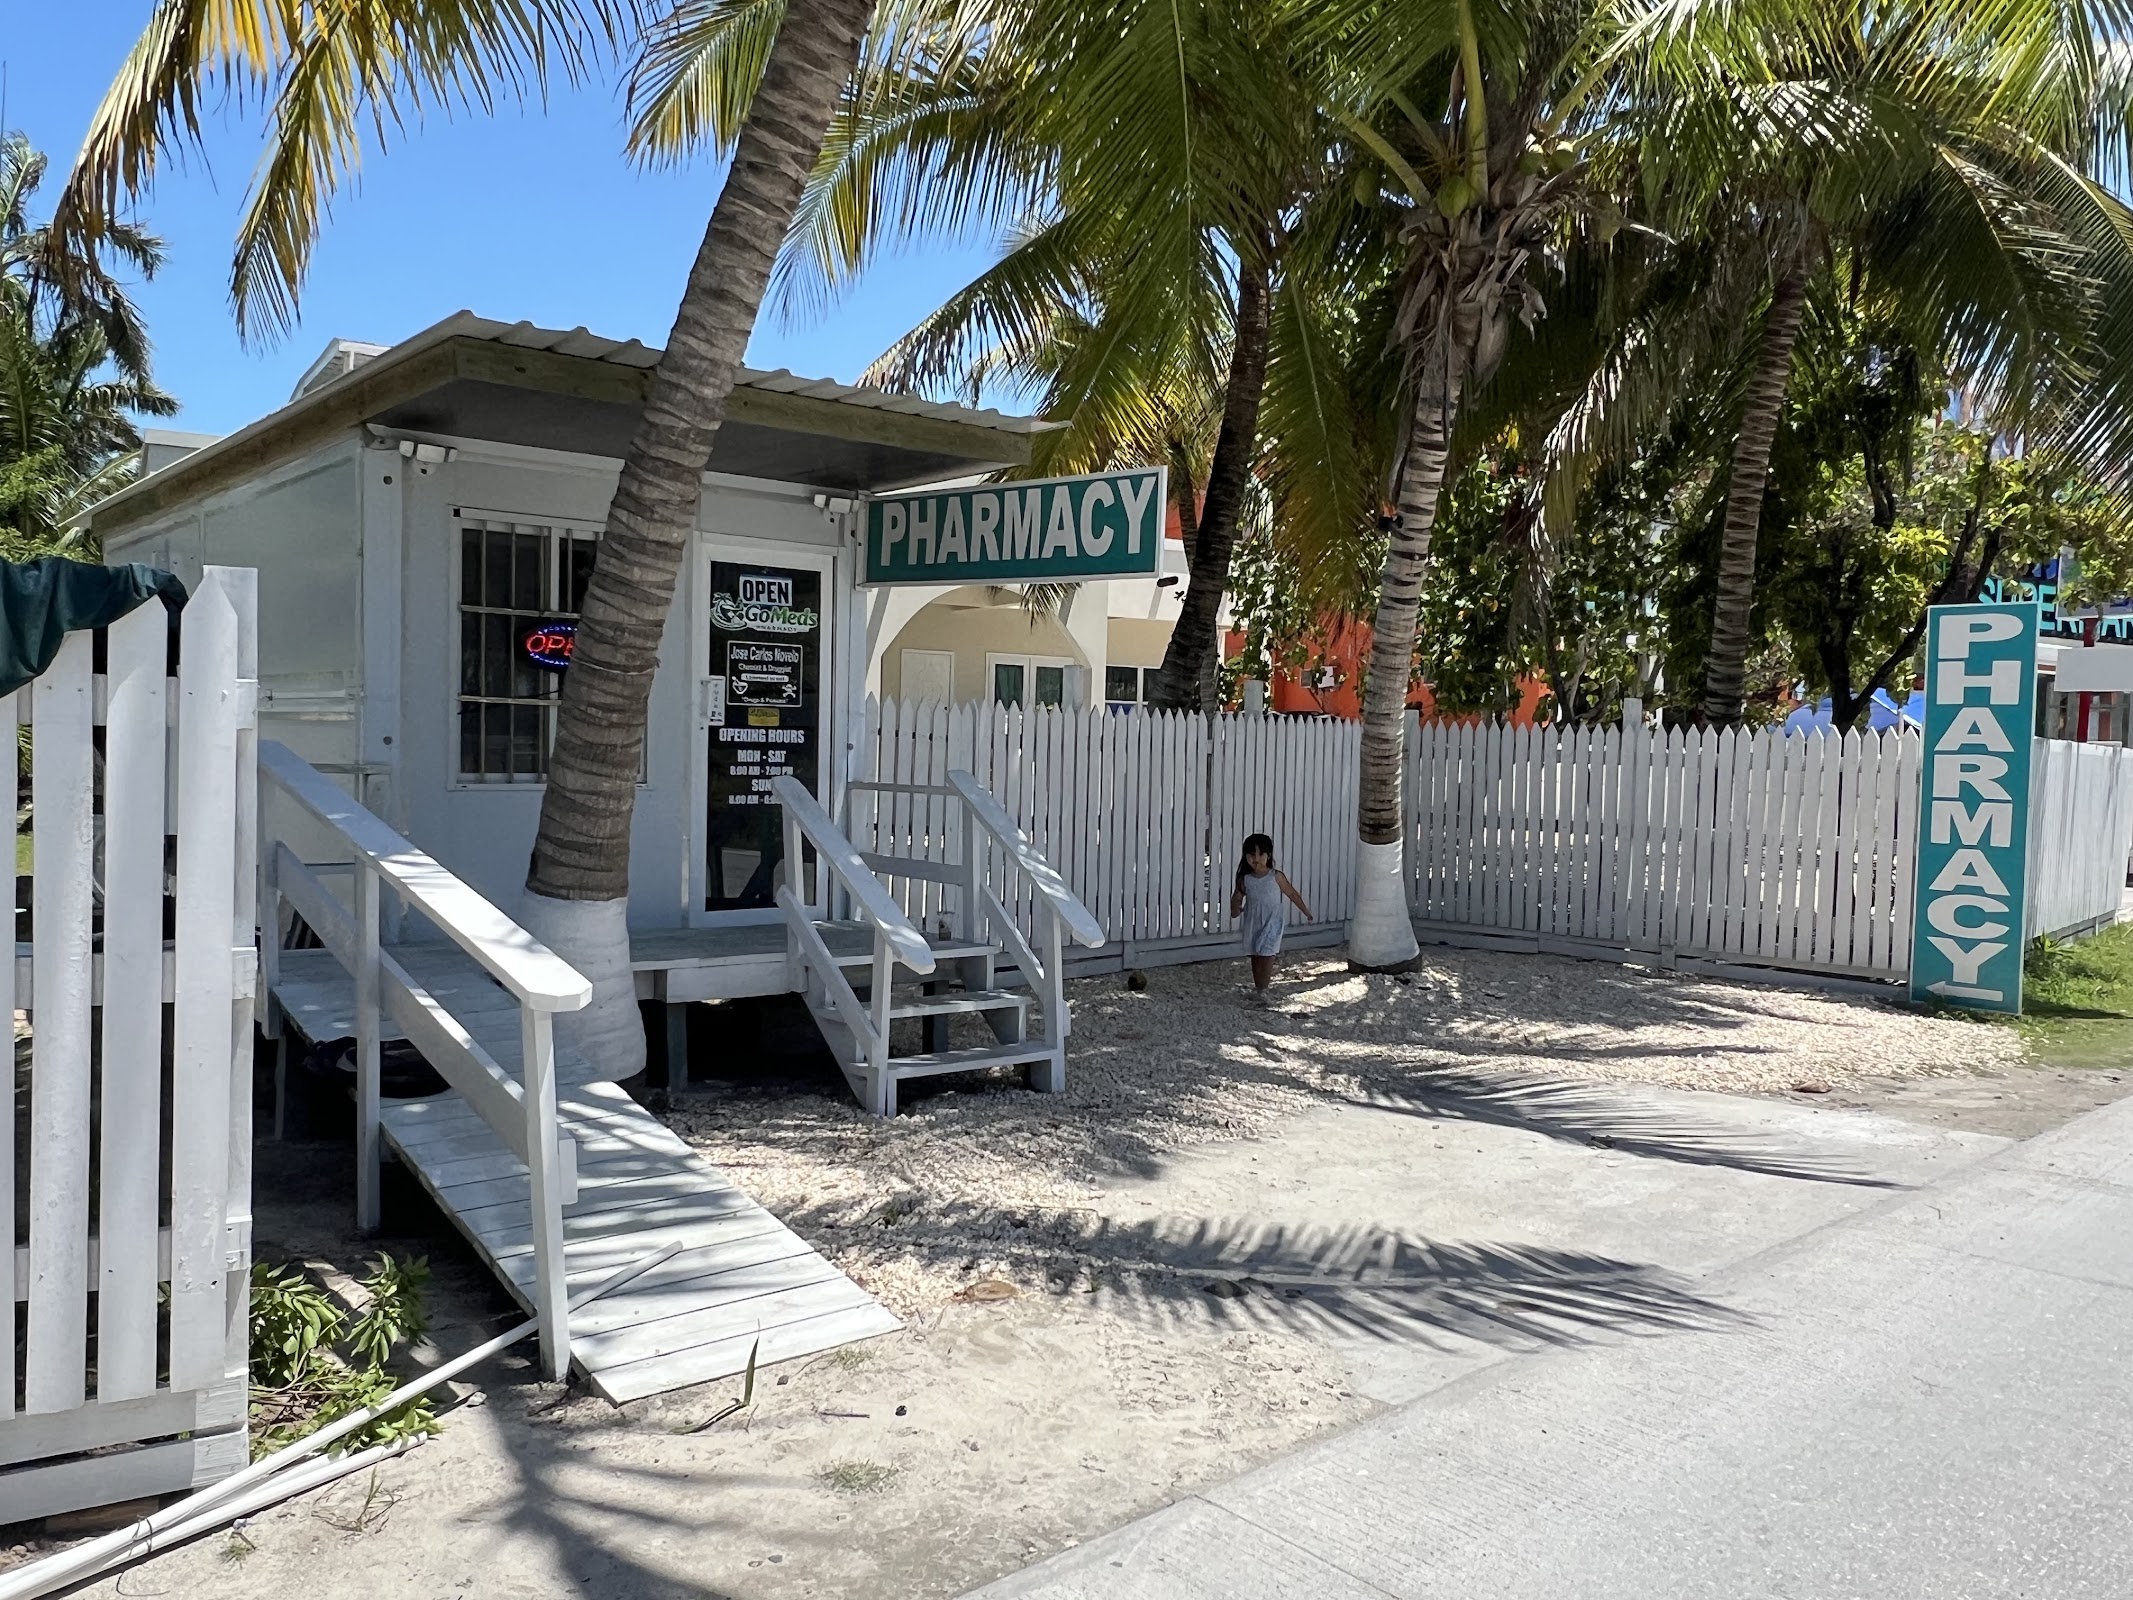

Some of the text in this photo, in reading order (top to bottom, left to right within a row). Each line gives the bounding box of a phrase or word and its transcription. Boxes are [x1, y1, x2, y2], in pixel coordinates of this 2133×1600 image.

[881, 476, 1157, 566] PHARMACY
[742, 579, 789, 604] OPEN
[745, 605, 818, 626] GoMeds
[730, 646, 748, 660] Jose
[750, 646, 773, 661] Carlos
[719, 728, 805, 743] OPENING HOURS
[737, 749, 760, 762] MON
[768, 750, 786, 763] SAT
[748, 766, 760, 775] AM
[782, 766, 793, 775] PM
[752, 778, 772, 791] SUN
[747, 795, 759, 804] AM
[1926, 614, 2024, 985] PHARMACY
